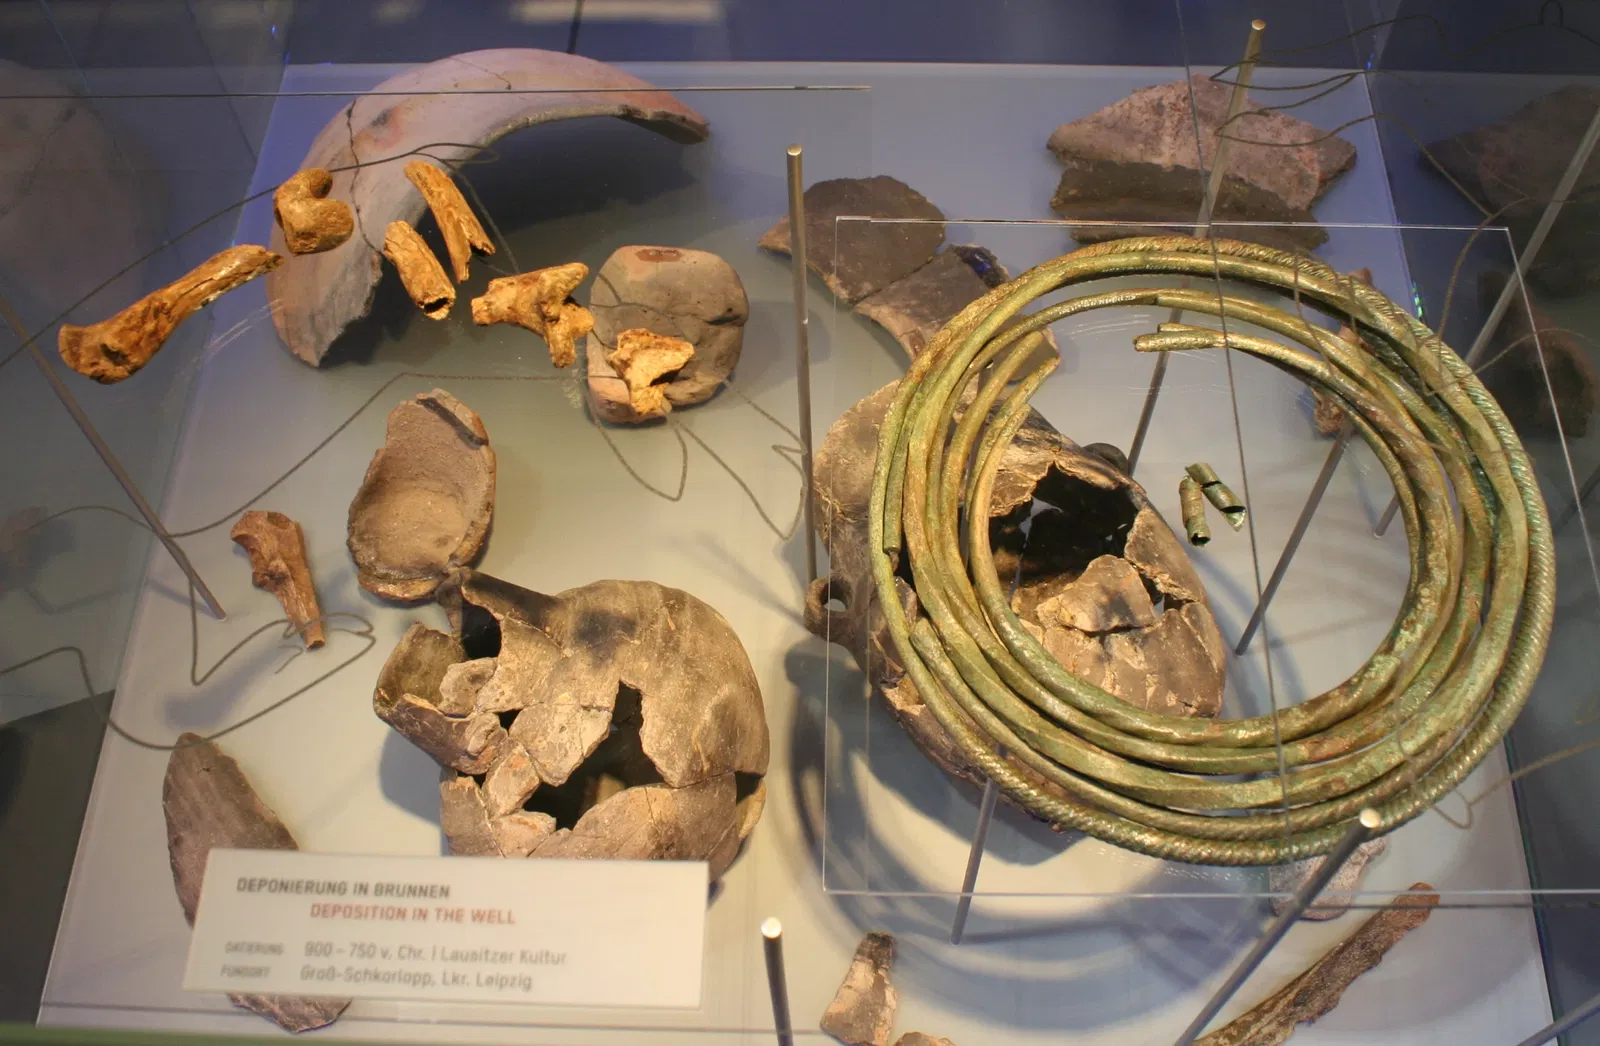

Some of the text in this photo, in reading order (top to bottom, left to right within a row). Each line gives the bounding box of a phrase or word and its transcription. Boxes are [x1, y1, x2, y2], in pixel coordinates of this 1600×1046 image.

[236, 877, 451, 899] DEPONIERUNG IN BRUNNEN
[310, 903, 516, 925] DEPOSITION IN THE WELL
[349, 942, 377, 959] 750
[440, 946, 514, 965] Lausitzer
[519, 949, 567, 966] Kultur
[476, 973, 533, 993] Leipzig
